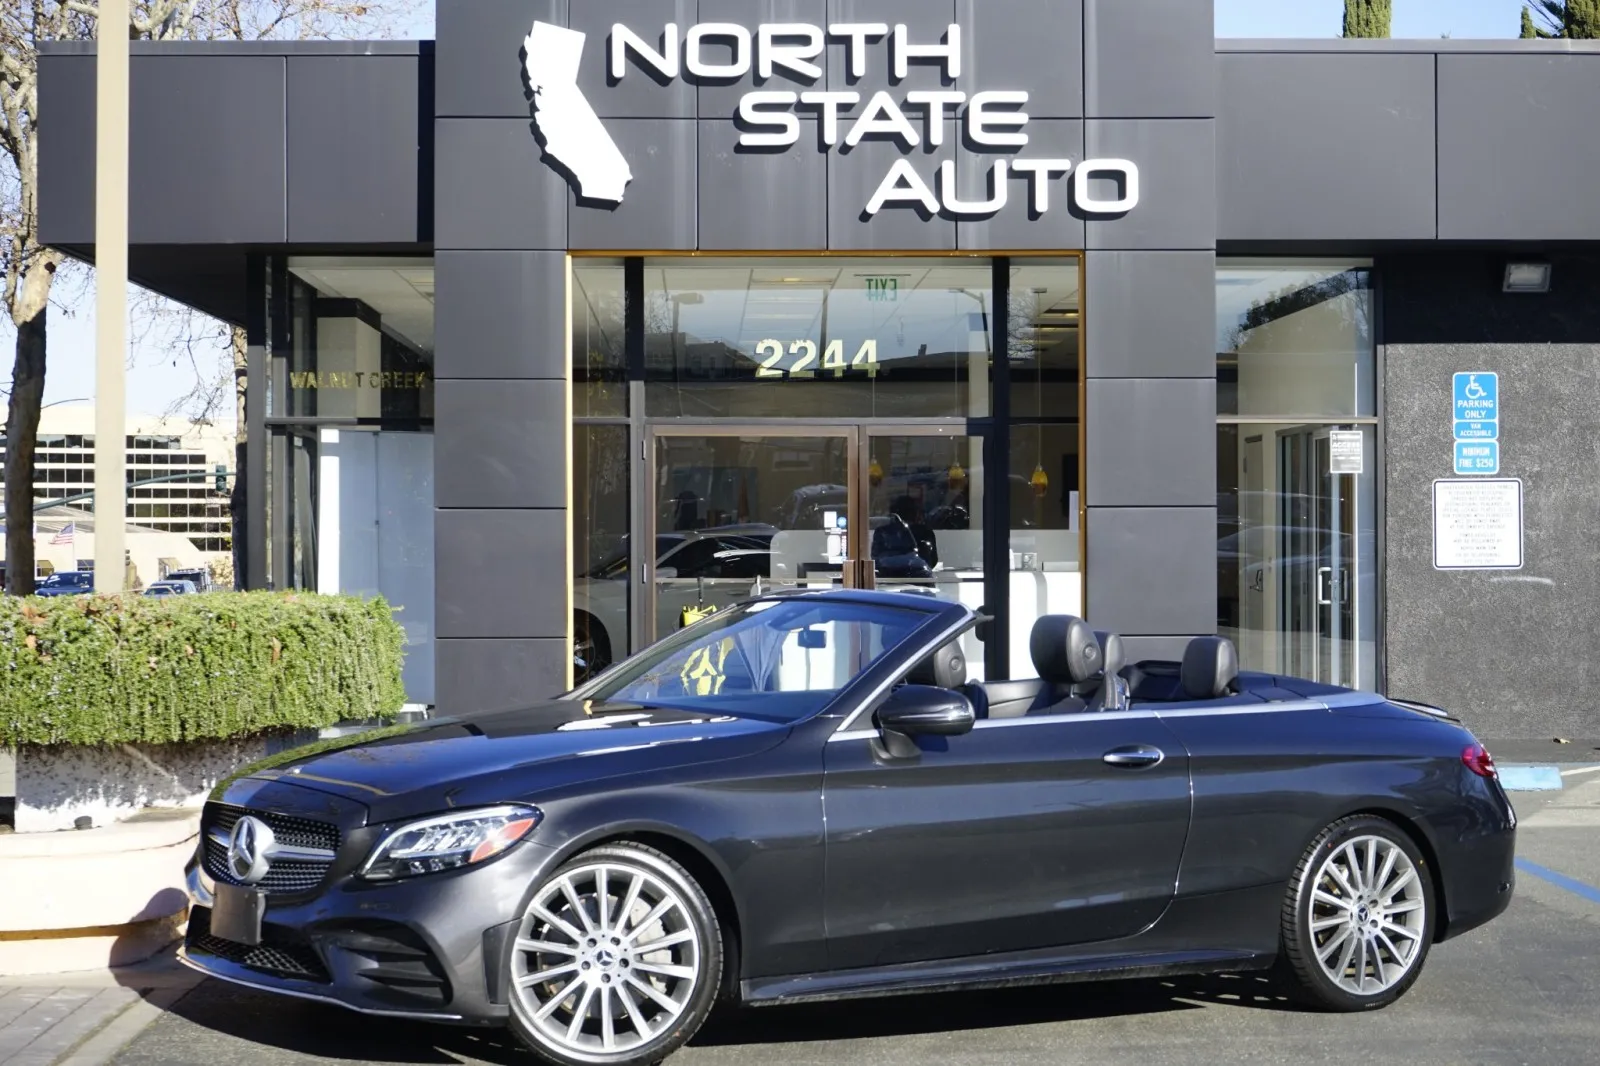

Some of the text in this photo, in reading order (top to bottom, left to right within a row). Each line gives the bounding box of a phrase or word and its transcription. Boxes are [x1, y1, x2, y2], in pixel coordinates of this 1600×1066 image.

[611, 22, 961, 78] NORTH
[739, 90, 1029, 146] STATE
[865, 158, 1140, 214] AUTO
[755, 338, 881, 378] 2244
[289, 371, 426, 389] WALNUT CREEK
[1457, 399, 1494, 408] PARKING
[1464, 410, 1487, 418] ONLY
[1475, 457, 1494, 469] $250
